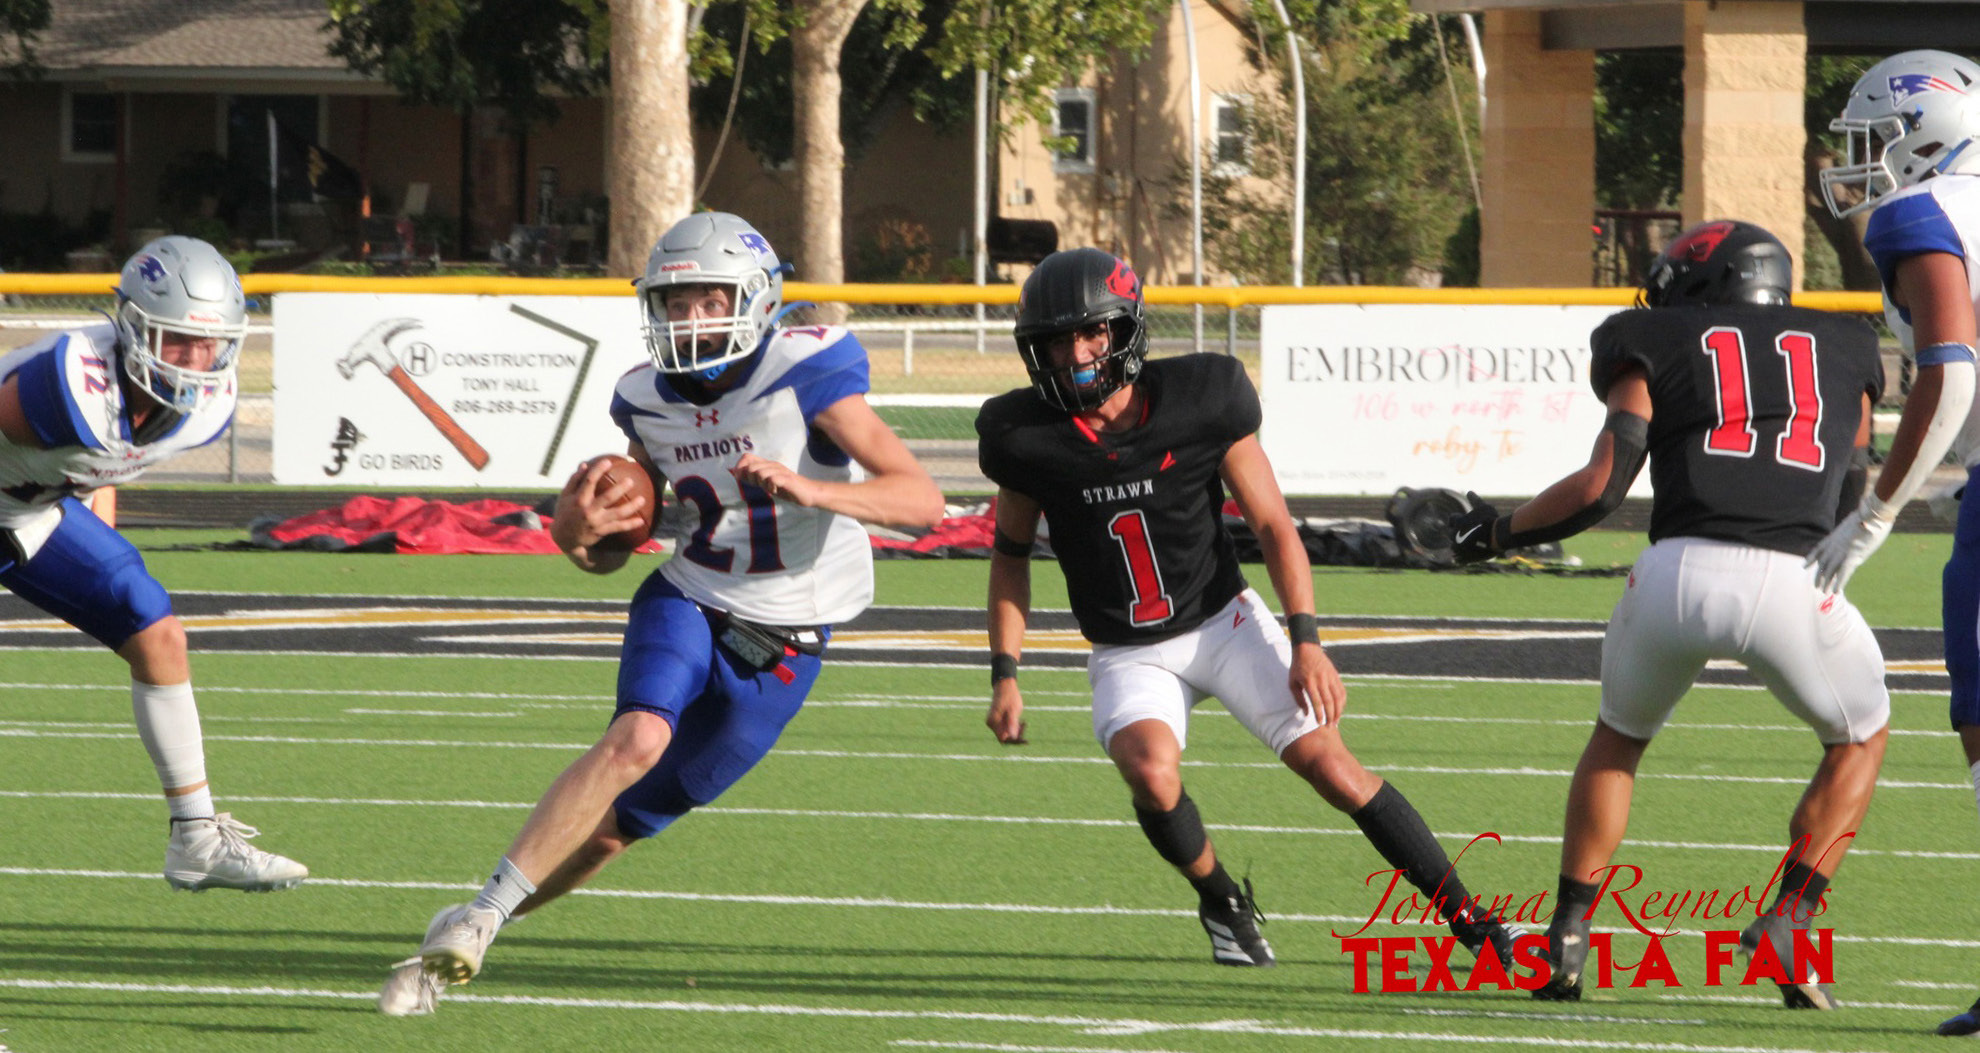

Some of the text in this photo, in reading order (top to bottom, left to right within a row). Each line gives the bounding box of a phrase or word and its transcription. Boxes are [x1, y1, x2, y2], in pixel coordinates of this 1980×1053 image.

[80, 354, 110, 396] 12
[442, 352, 577, 368] CONSTRUCTION
[1286, 345, 1586, 388] EMBROIDERY
[462, 376, 541, 393] TONY HALL
[1702, 326, 1825, 471] 11
[1353, 391, 1400, 421] 106
[1451, 389, 1524, 421] north
[359, 454, 444, 470] GO BIRDS
[674, 434, 754, 463] PATRIOTS
[1082, 479, 1154, 504] STRAWN
[675, 468, 786, 574] 21
[1108, 509, 1174, 628] 1
